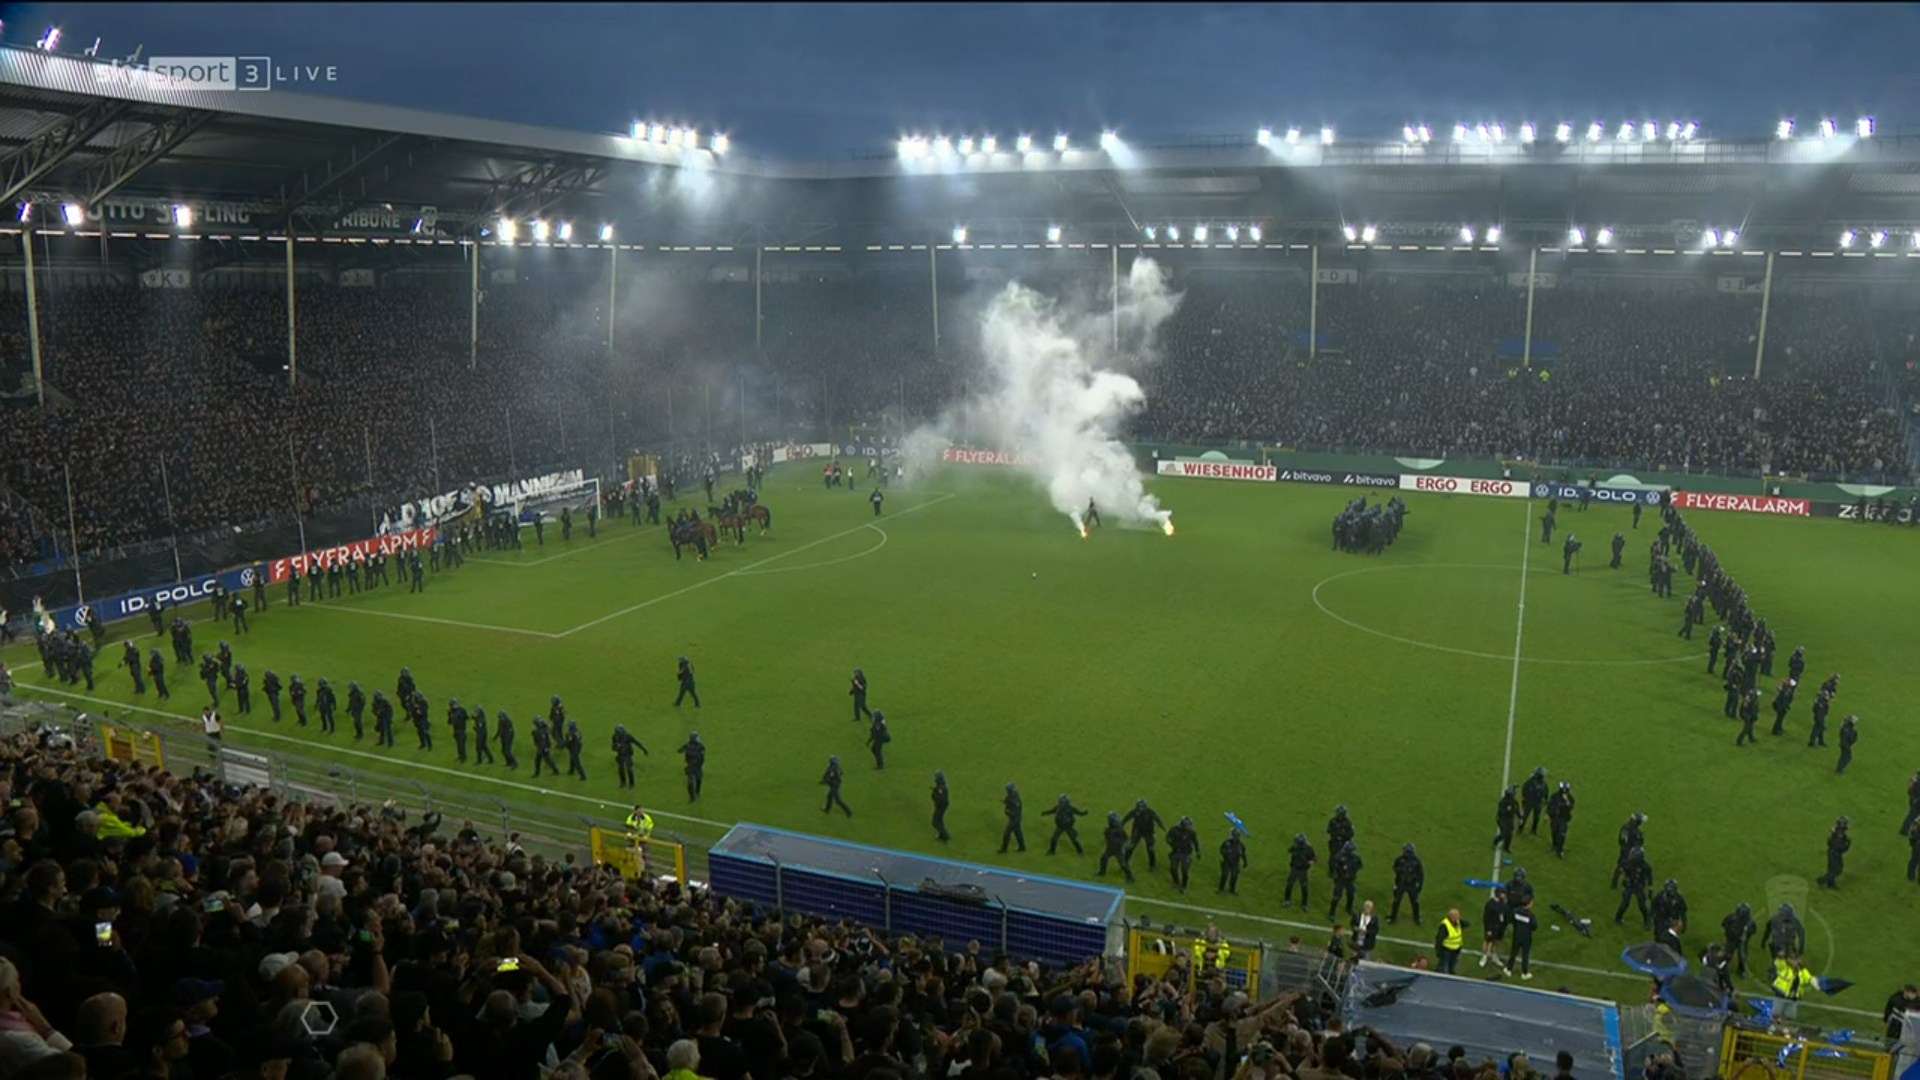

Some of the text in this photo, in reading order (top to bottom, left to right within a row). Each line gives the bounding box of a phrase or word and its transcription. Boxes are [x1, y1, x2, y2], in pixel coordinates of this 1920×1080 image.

[1184, 463, 1275, 479] WIESENHOF
[1293, 471, 1332, 482] bitvavo
[1356, 475, 1395, 487] bitvavo
[1415, 477, 1512, 495] ERGO ERGO
[1558, 487, 1579, 498] ID.
[121, 597, 149, 614] ID.
